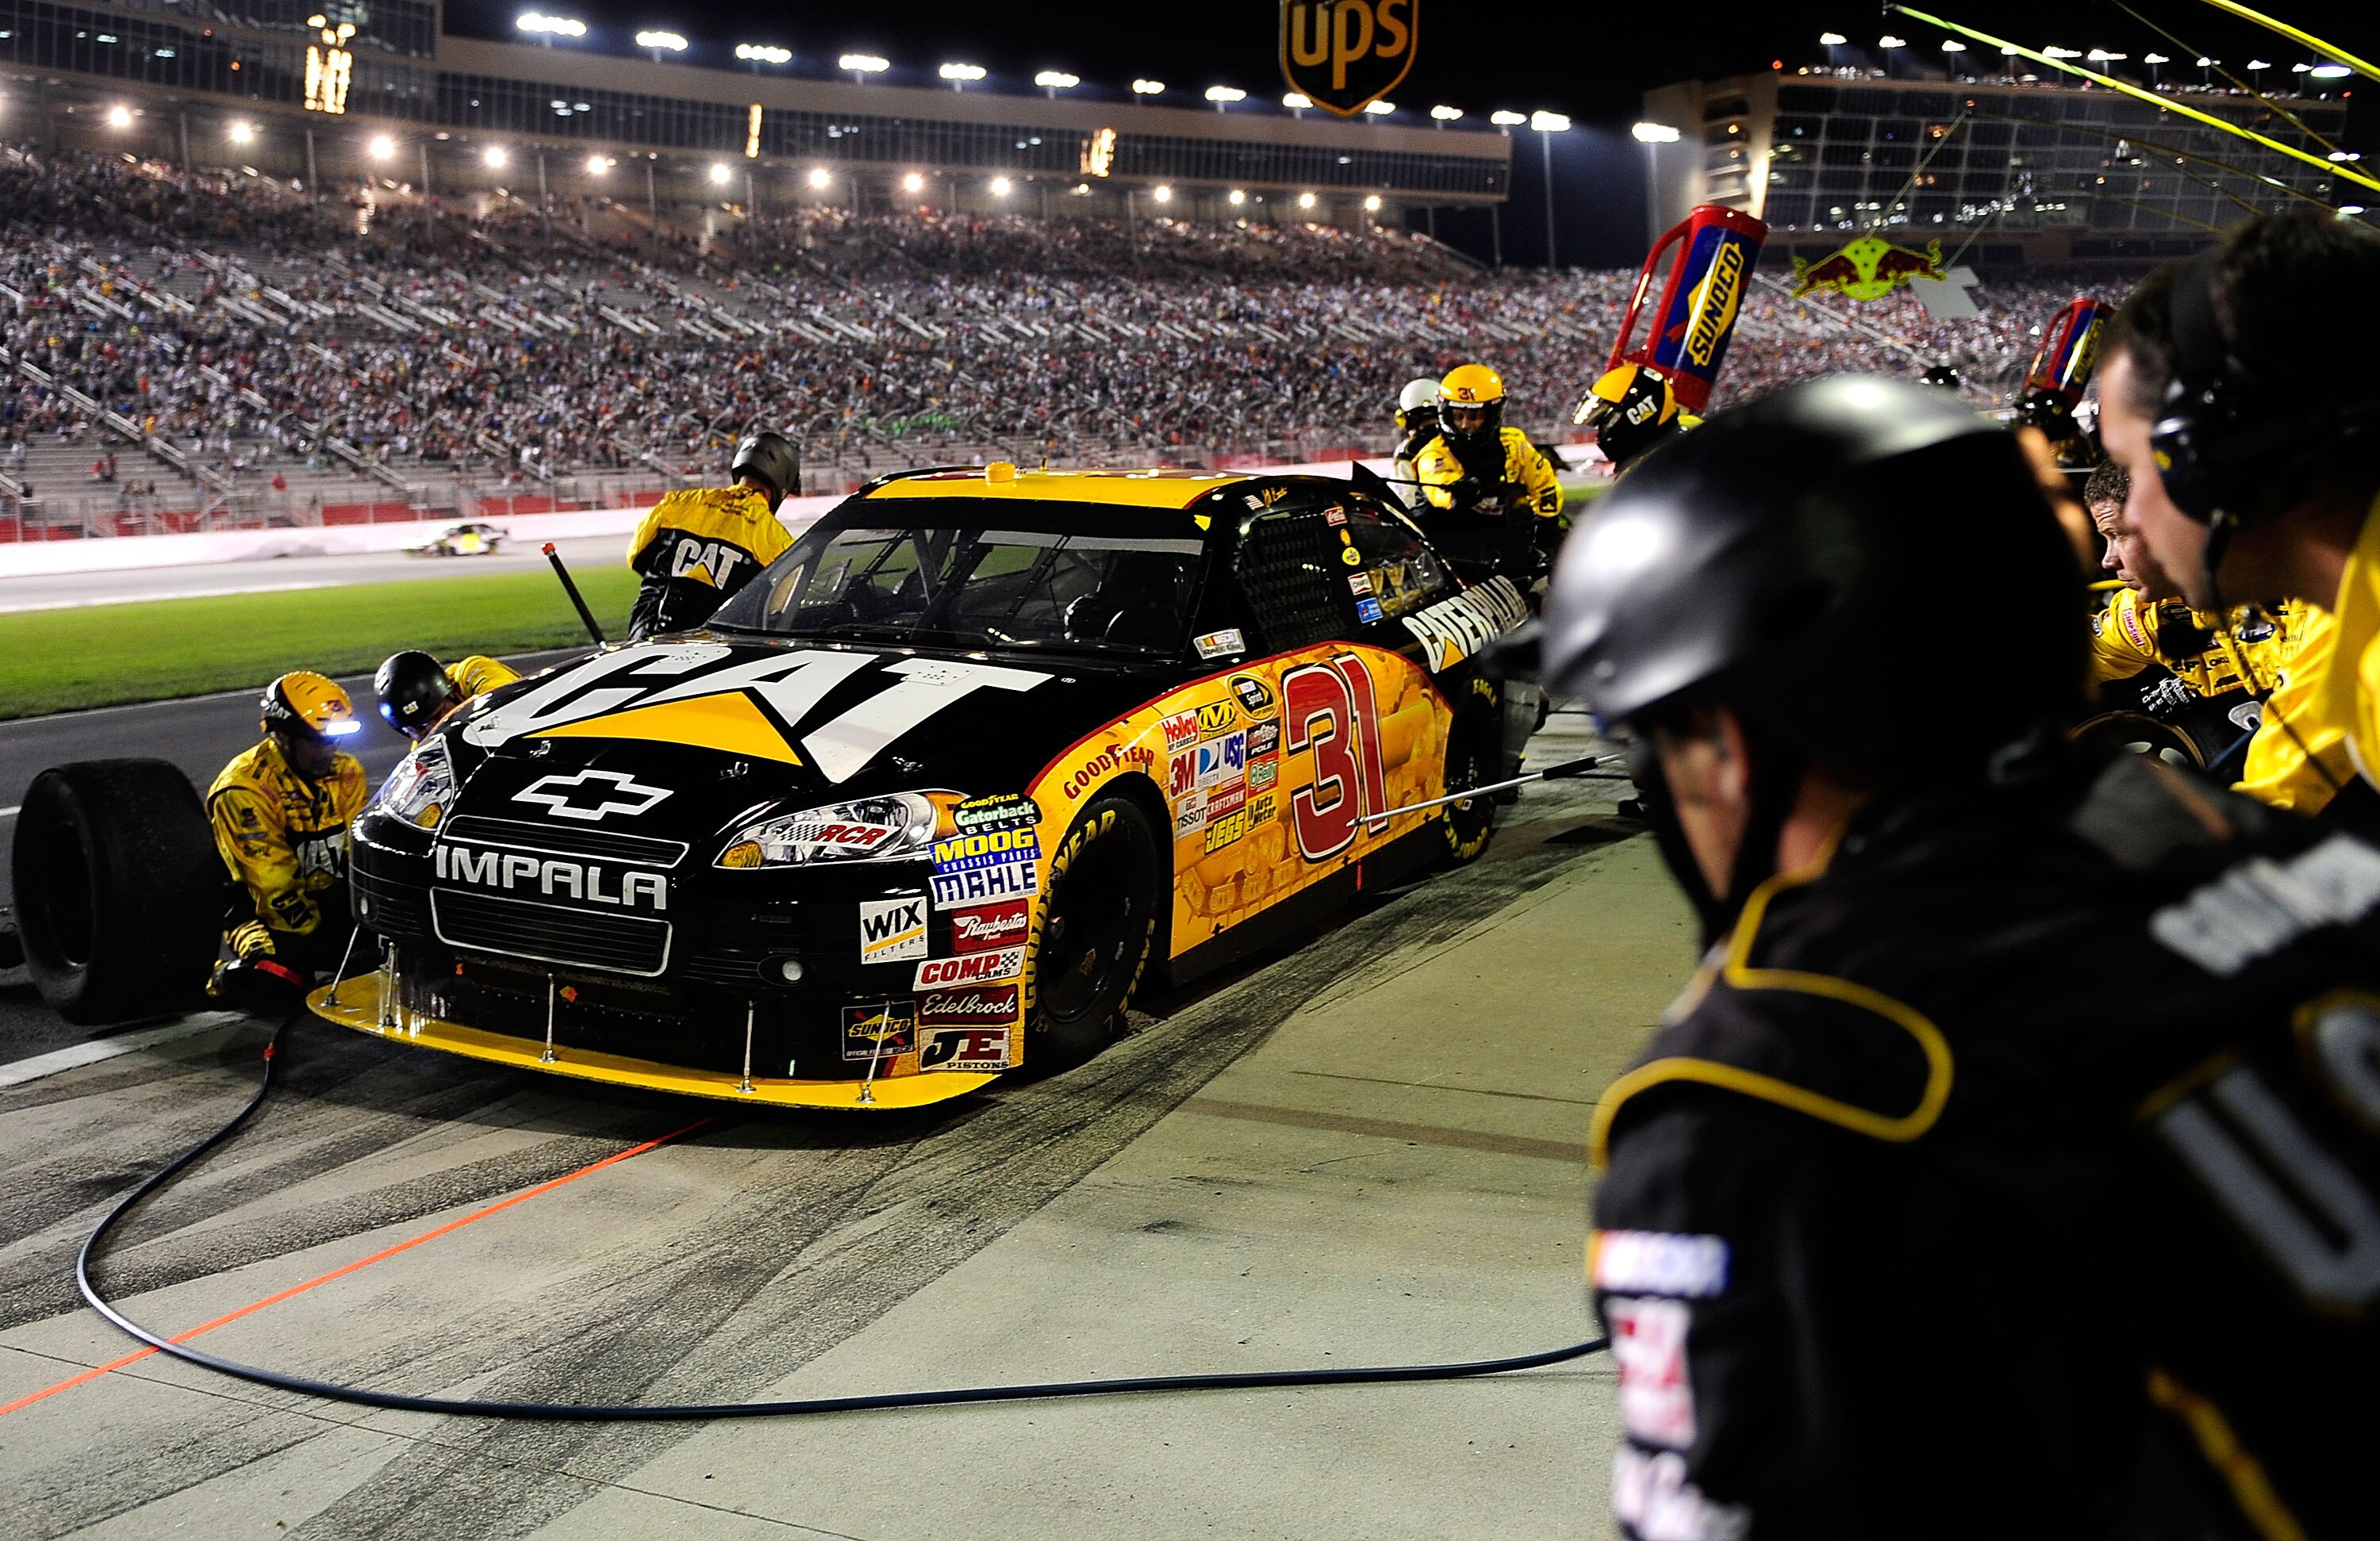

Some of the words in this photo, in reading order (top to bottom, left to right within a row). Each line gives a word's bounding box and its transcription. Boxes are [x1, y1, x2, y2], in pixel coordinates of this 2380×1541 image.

[1292, 0, 1408, 90] ups
[1692, 247, 1741, 356] SUNOCO
[1626, 395, 1659, 426] CAT
[672, 539, 743, 590] CAT
[2123, 608, 2145, 647] SIMPSON
[463, 646, 1055, 784] CAT
[1161, 715, 1198, 744] Holley
[1224, 733, 1244, 771] USG
[1251, 742, 1273, 755] POLE
[1282, 653, 1389, 860] 31
[1170, 753, 1196, 797] 3M
[955, 801, 1035, 826] Gatorback
[1207, 790, 1246, 815] CRAFTSMAN
[965, 816, 1037, 835] BELTS
[1177, 807, 1206, 830] TISSOT
[1206, 815, 1245, 853] JEGS
[814, 825, 887, 845] RCR
[935, 827, 1035, 864] MOOG
[942, 854, 995, 873] CHASSIS
[1000, 849, 1036, 863] PARTS
[436, 845, 667, 910] IMPALA
[932, 862, 1037, 903] MAHLE
[863, 899, 923, 943] WIX
[953, 912, 1027, 941] Raybestos
[865, 934, 925, 961] FILTERS
[920, 953, 1001, 985] COMP
[974, 966, 1012, 981] CAMS
[922, 994, 1016, 1016] Edelbrock
[849, 1019, 910, 1036] SUNOCO
[922, 1030, 1005, 1068] JE
[946, 1060, 1009, 1070] PISTONS
